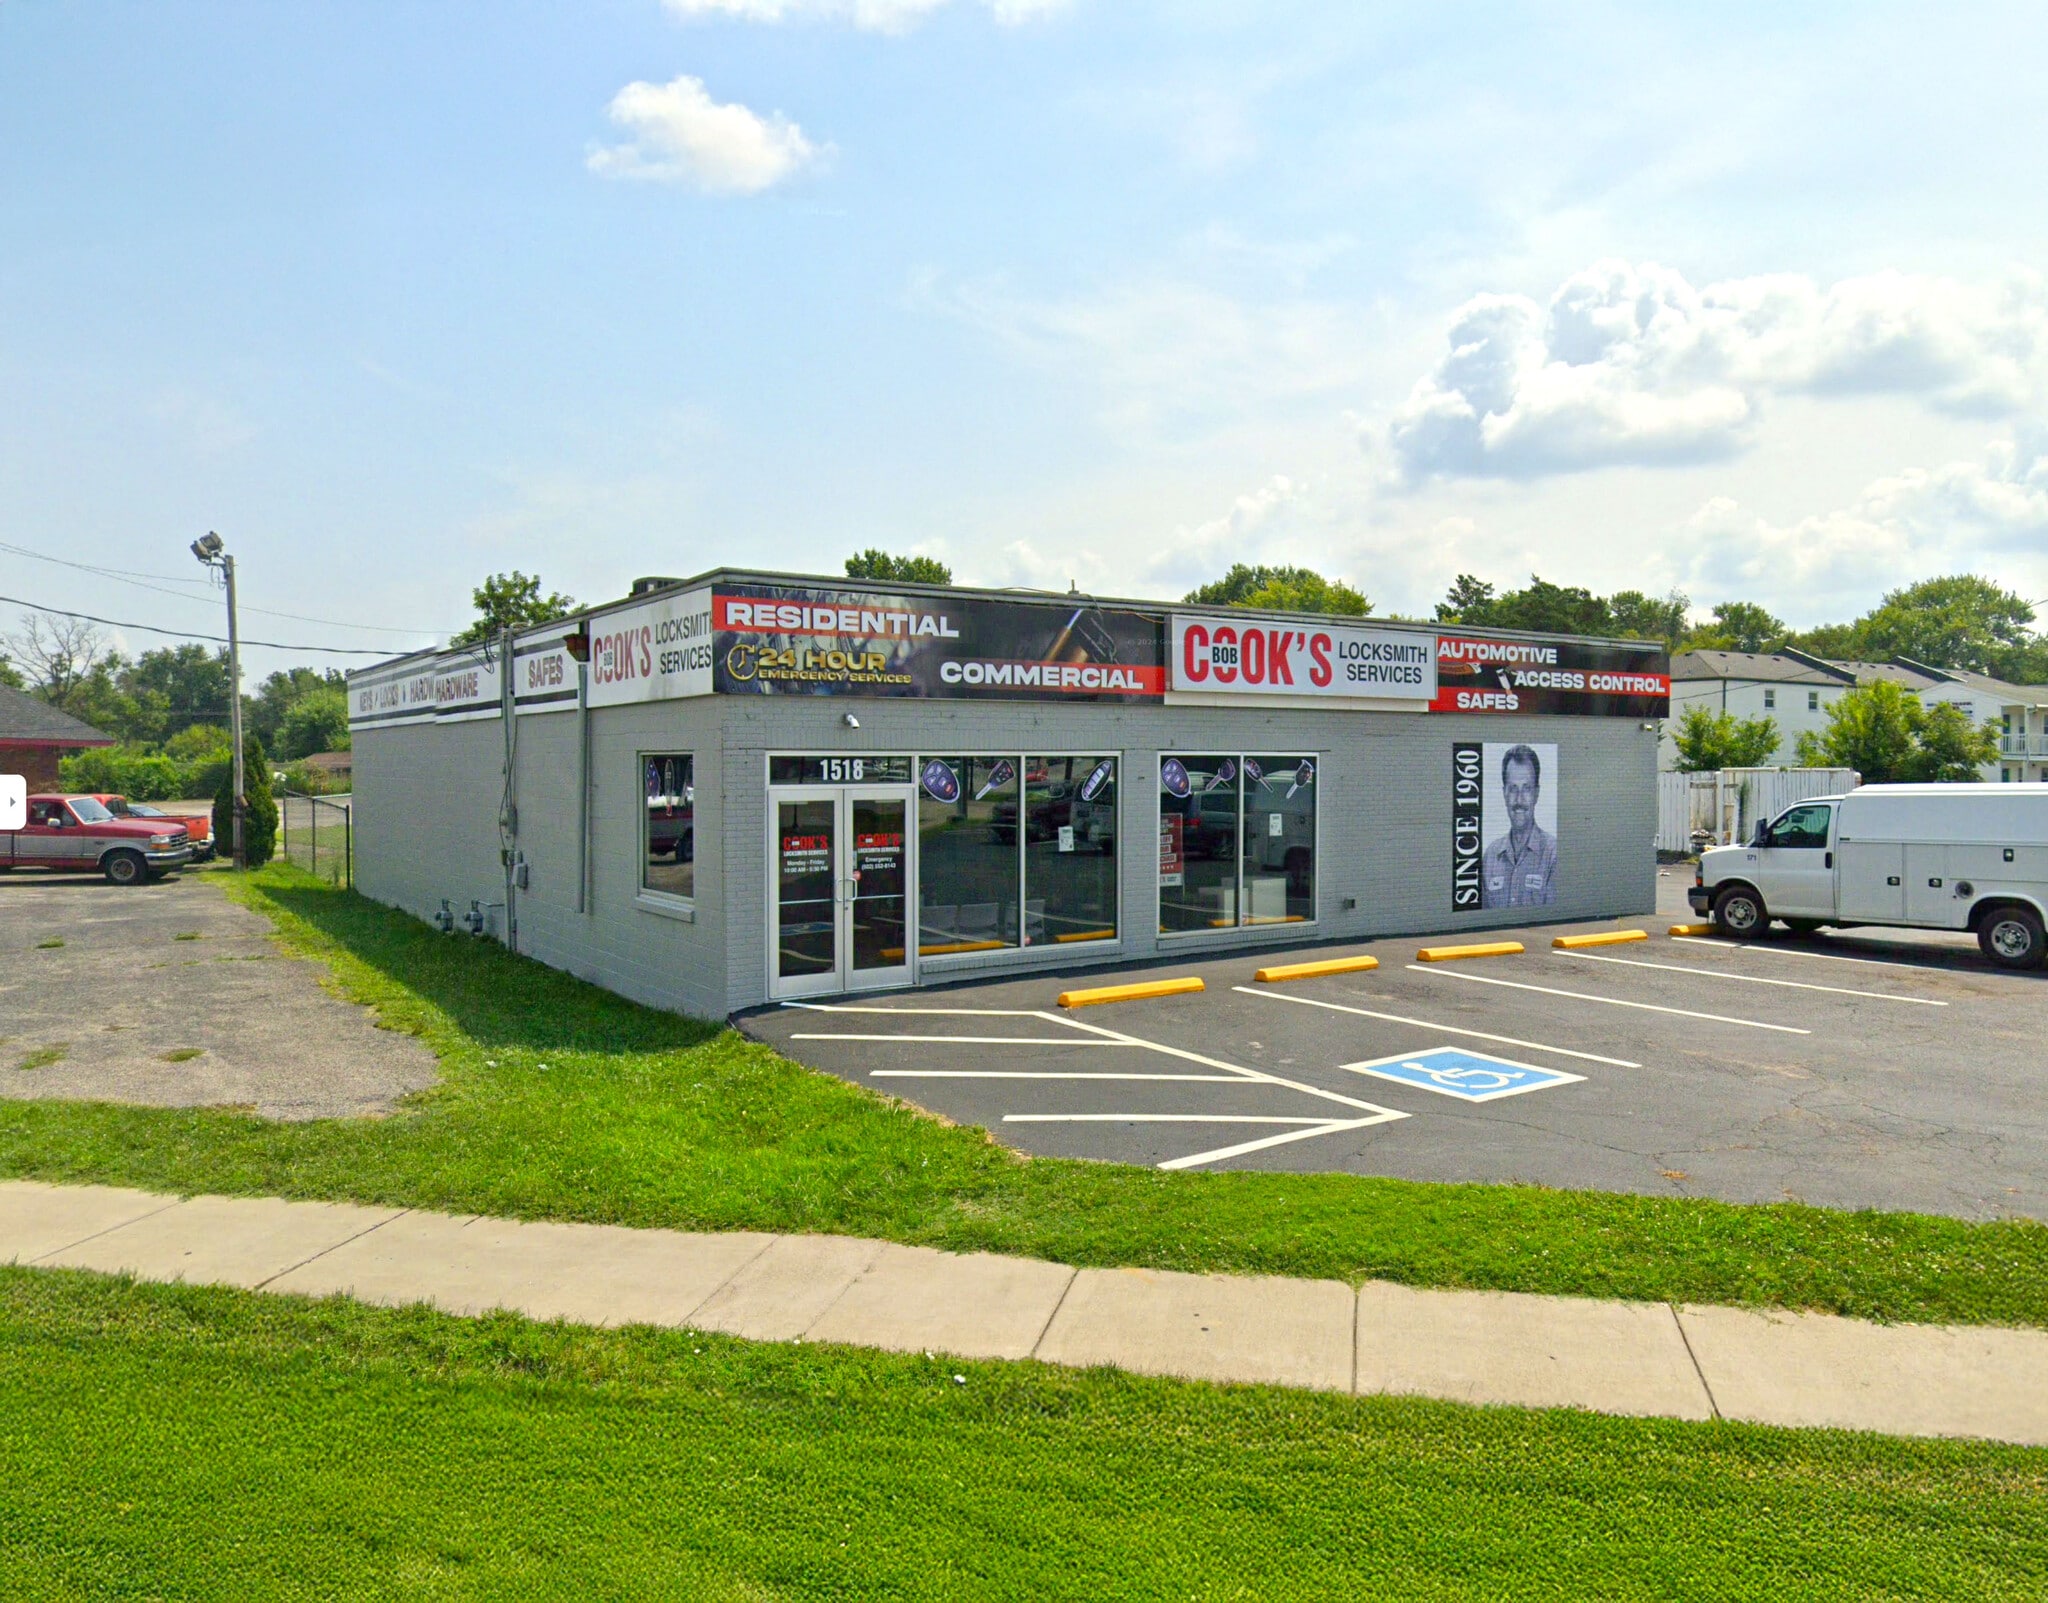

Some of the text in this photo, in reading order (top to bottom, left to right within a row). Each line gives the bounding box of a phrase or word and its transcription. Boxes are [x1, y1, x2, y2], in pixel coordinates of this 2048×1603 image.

[726, 601, 959, 638] RESIDENTIAL
[593, 625, 652, 685] COOK'S
[603, 651, 613, 667] BOB
[660, 644, 712, 675] SERVICES
[758, 648, 887, 671] 24 HOUR
[1183, 624, 1333, 688] COOK'S
[1212, 646, 1238, 665] BOB
[1339, 641, 1428, 664] LOCKSMITH
[1438, 641, 1558, 664] AUTOMOTIVE
[528, 654, 564, 689] SAFES
[758, 668, 912, 684] EMERGENCY SERVICES
[940, 661, 1144, 690] COMMERCIAL
[1346, 664, 1423, 684] SERVICES
[1514, 670, 1665, 693] ACCESS CONTROL
[436, 672, 478, 702] HARDWARE
[1457, 692, 1519, 710] SAFES
[820, 759, 864, 781] 1518
[1455, 750, 1480, 904] SINCE 1960
[783, 835, 828, 851] COOK'S
[857, 832, 900, 848] COOK'S
